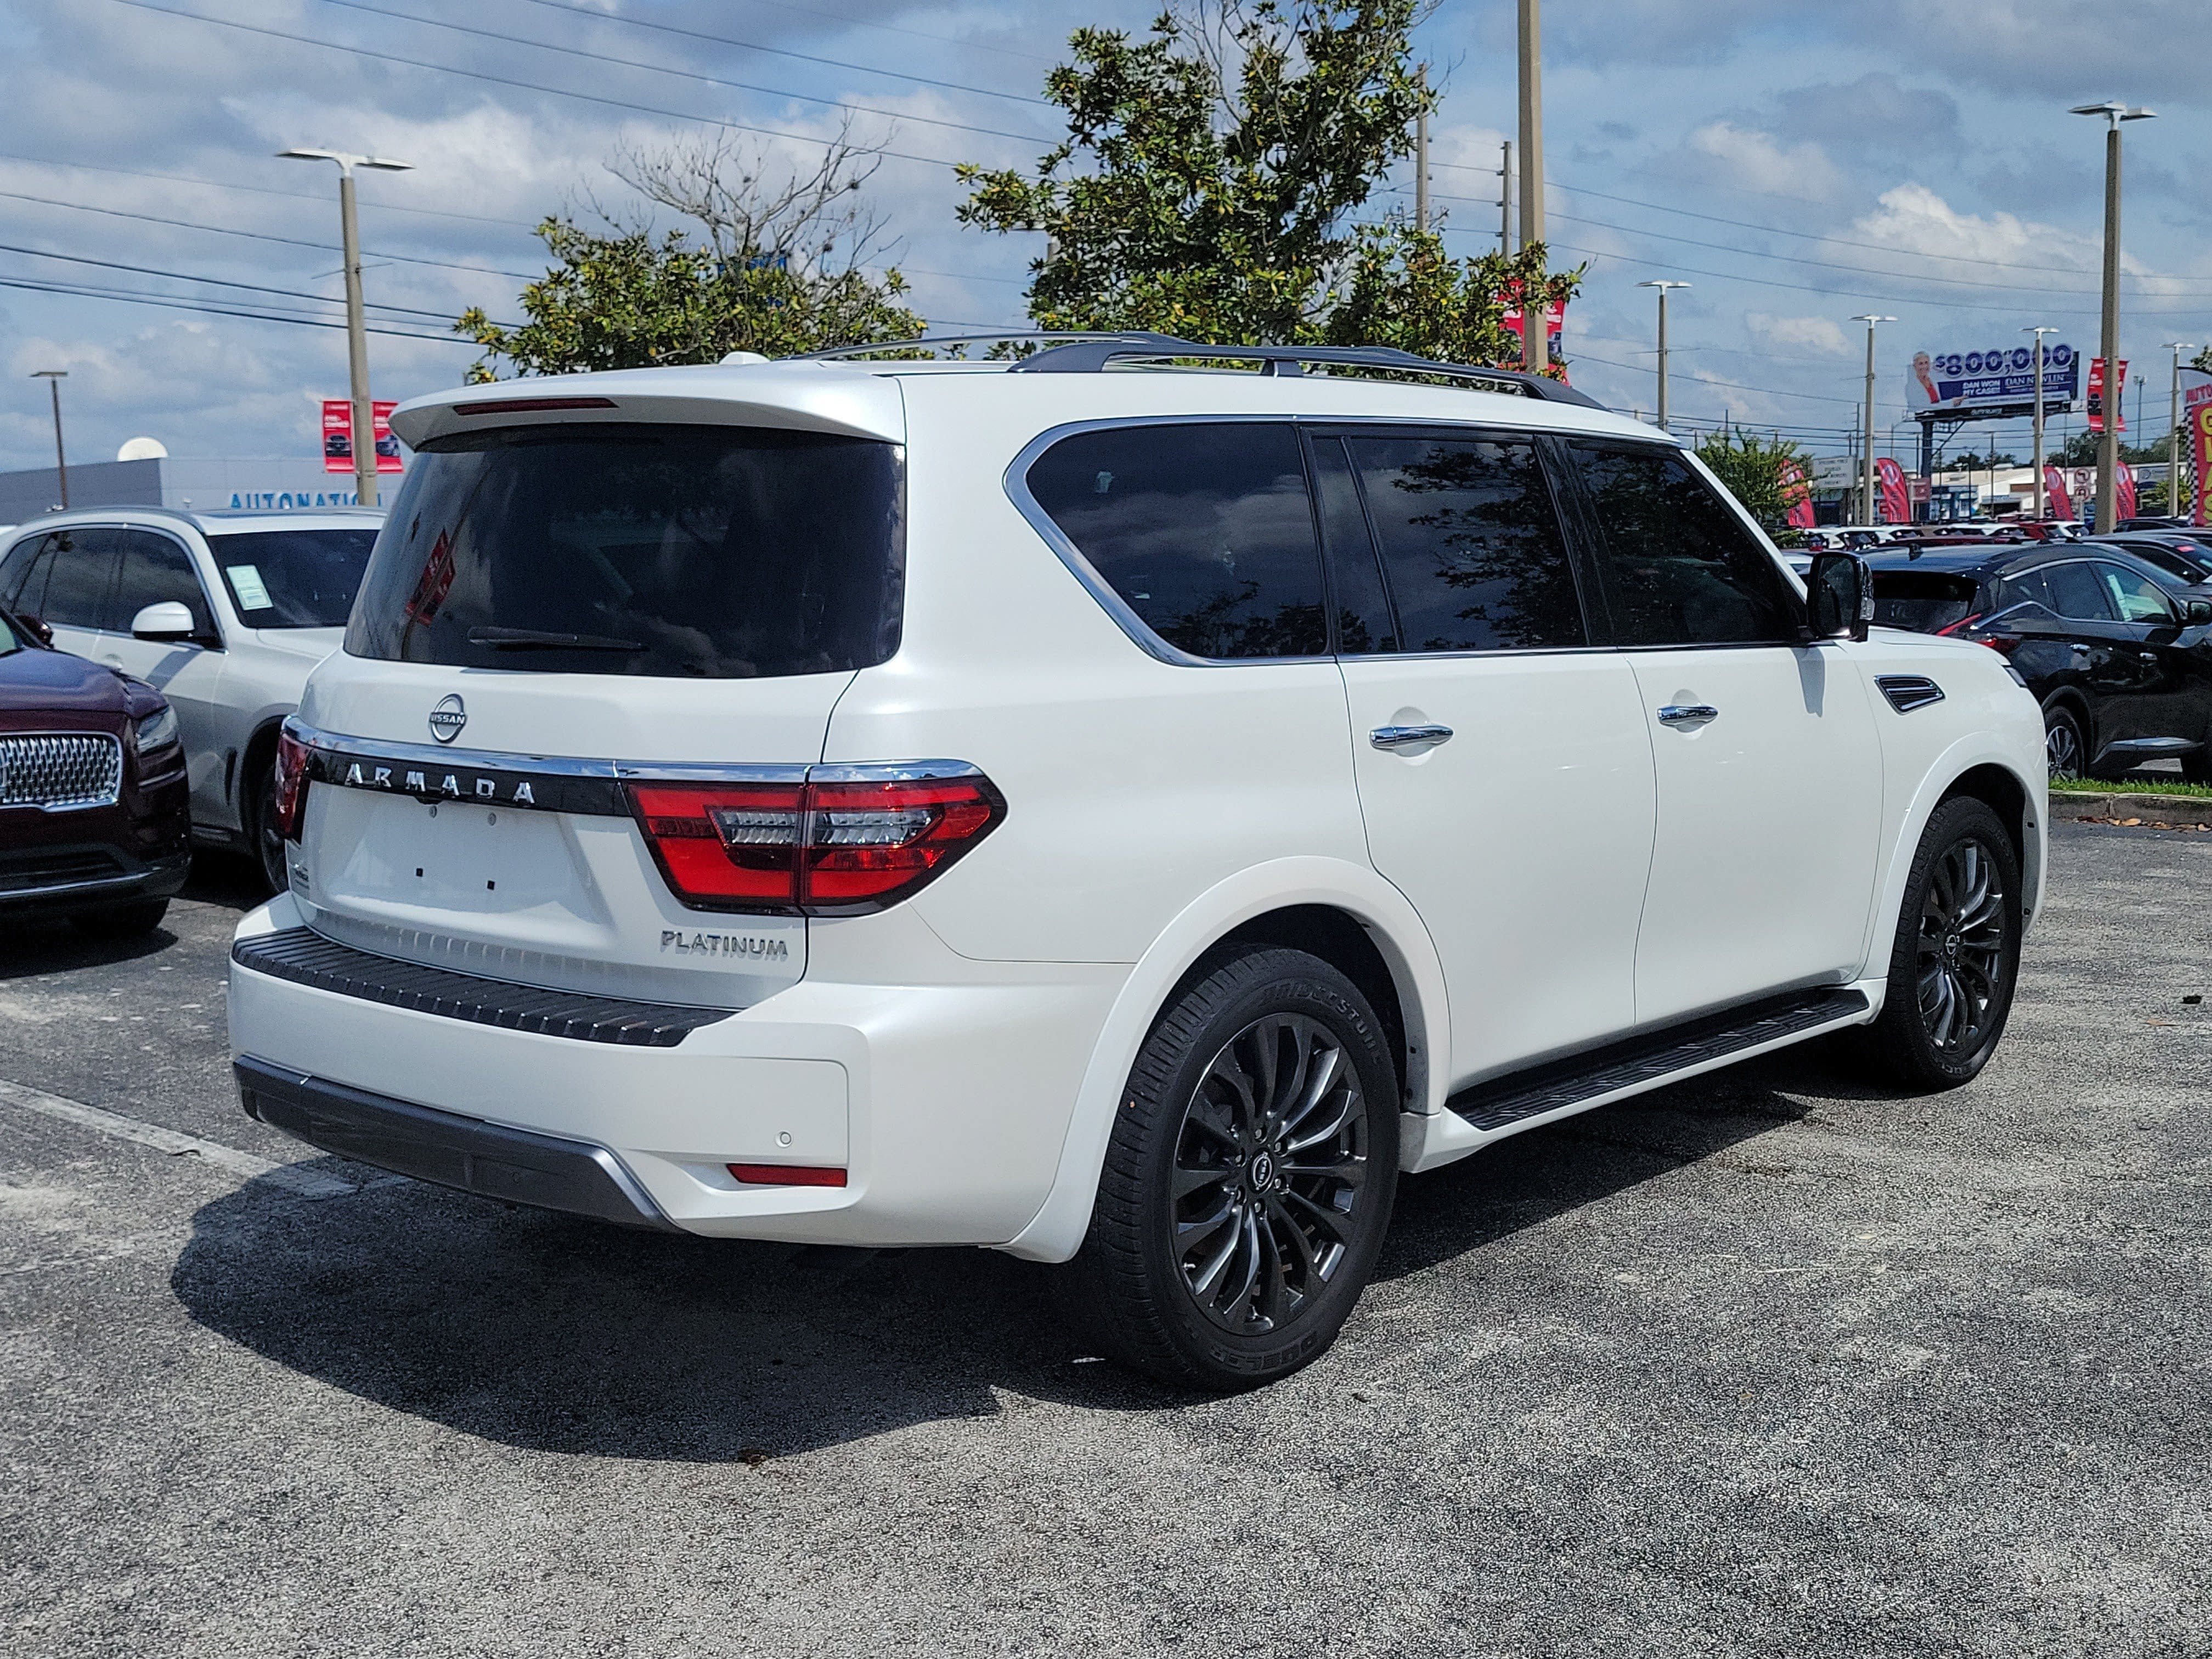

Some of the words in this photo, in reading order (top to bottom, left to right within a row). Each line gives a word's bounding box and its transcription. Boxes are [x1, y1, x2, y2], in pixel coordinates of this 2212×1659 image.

[1934, 345, 2072, 376] $800,000
[230, 493, 381, 509] AUTONATI
[430, 714, 465, 725] NISSAN
[345, 763, 535, 804] ARMADA
[662, 930, 788, 957] PLATINUM
